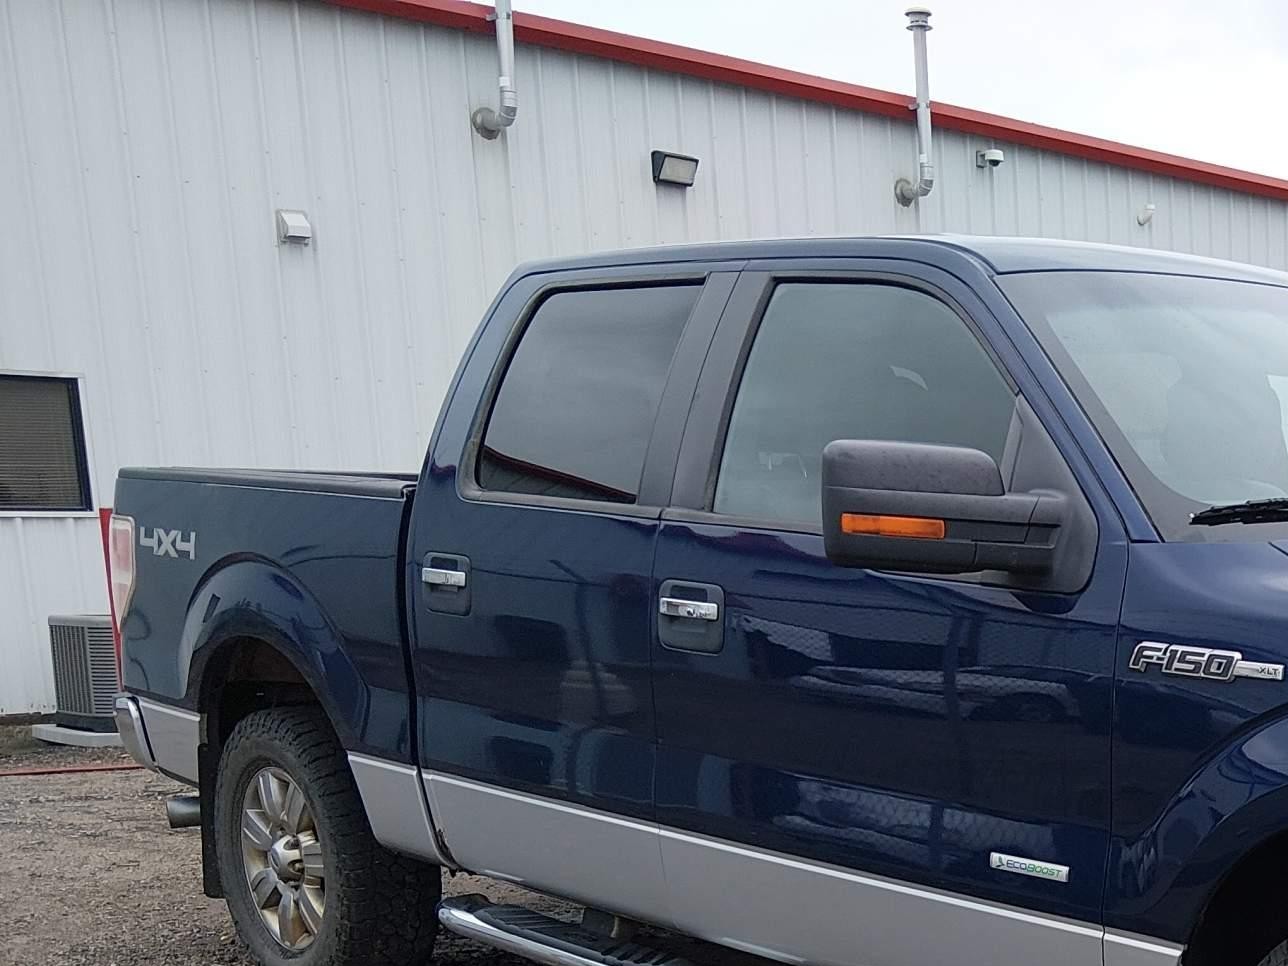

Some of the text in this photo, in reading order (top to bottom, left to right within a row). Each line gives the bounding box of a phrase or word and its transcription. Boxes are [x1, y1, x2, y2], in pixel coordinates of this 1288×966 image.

[1129, 641, 1280, 682] F-150 XLT
[1006, 859, 1064, 878] ECOBOOST
